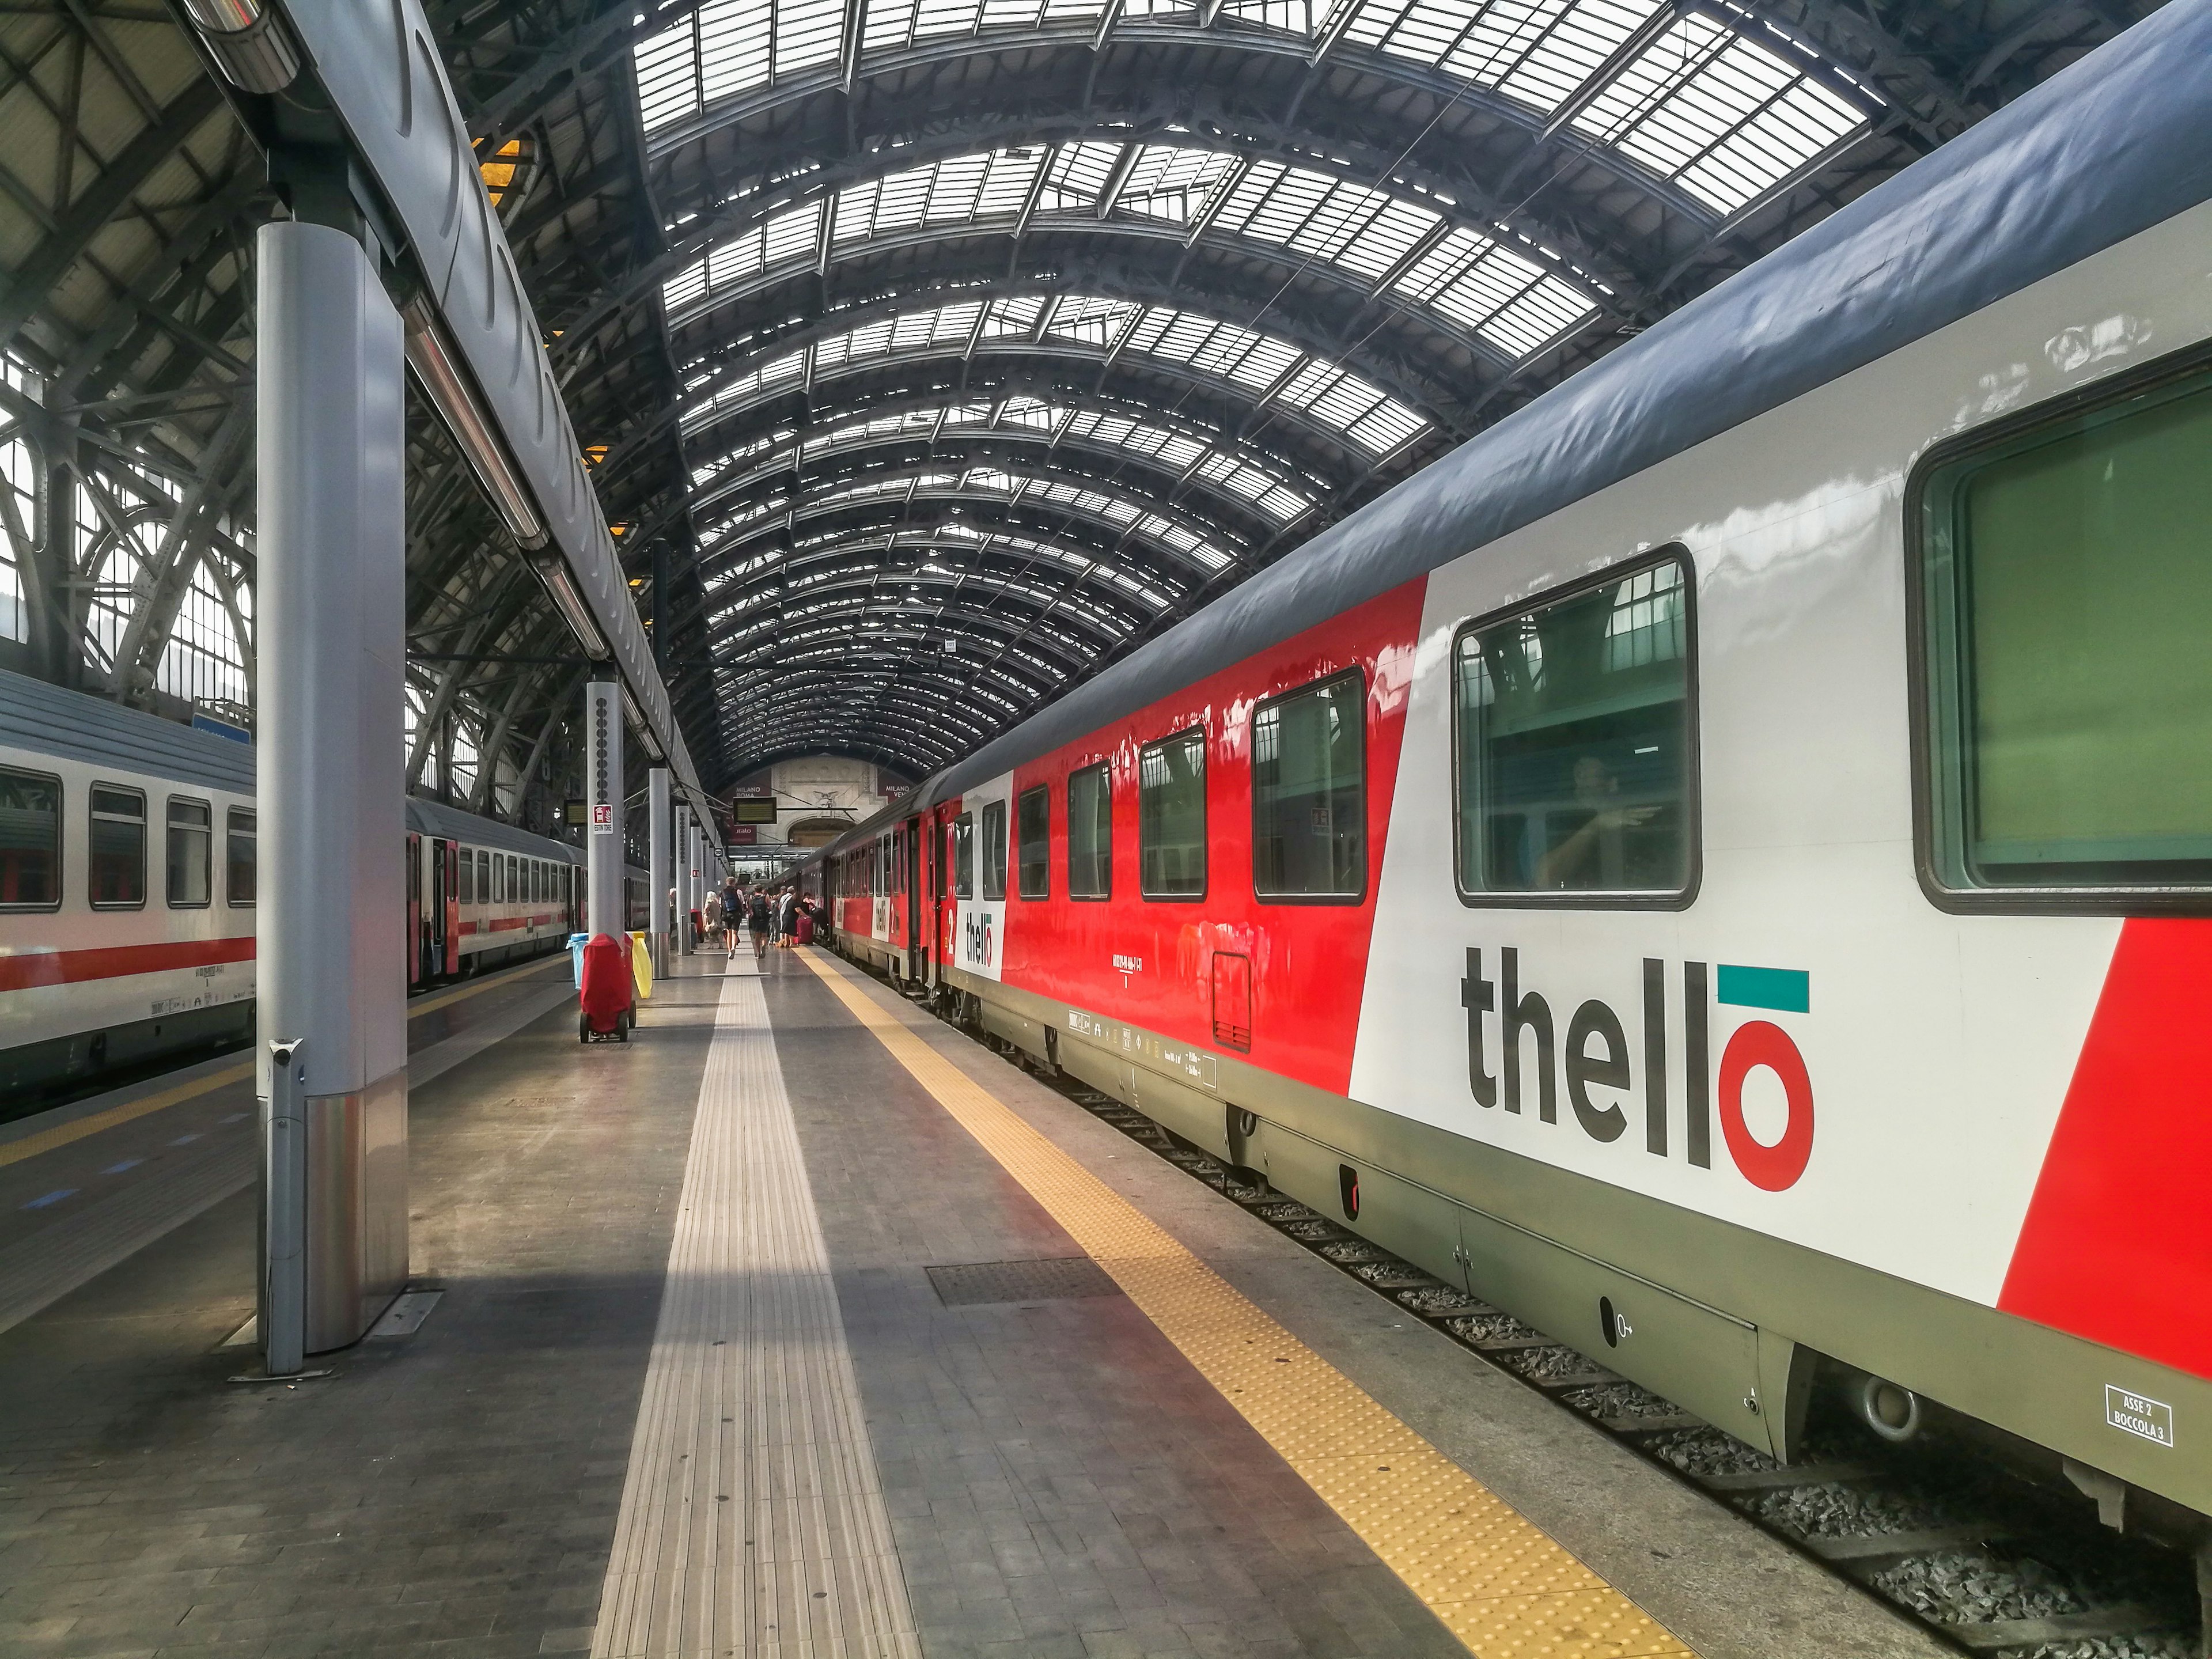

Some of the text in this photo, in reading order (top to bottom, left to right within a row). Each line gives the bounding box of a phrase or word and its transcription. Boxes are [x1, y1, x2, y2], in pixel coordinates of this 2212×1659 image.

[948, 908, 954, 955] 2
[2123, 1395, 2152, 1417] ASSE 2
[2114, 1410, 2164, 1440] BOCCOLA 3
